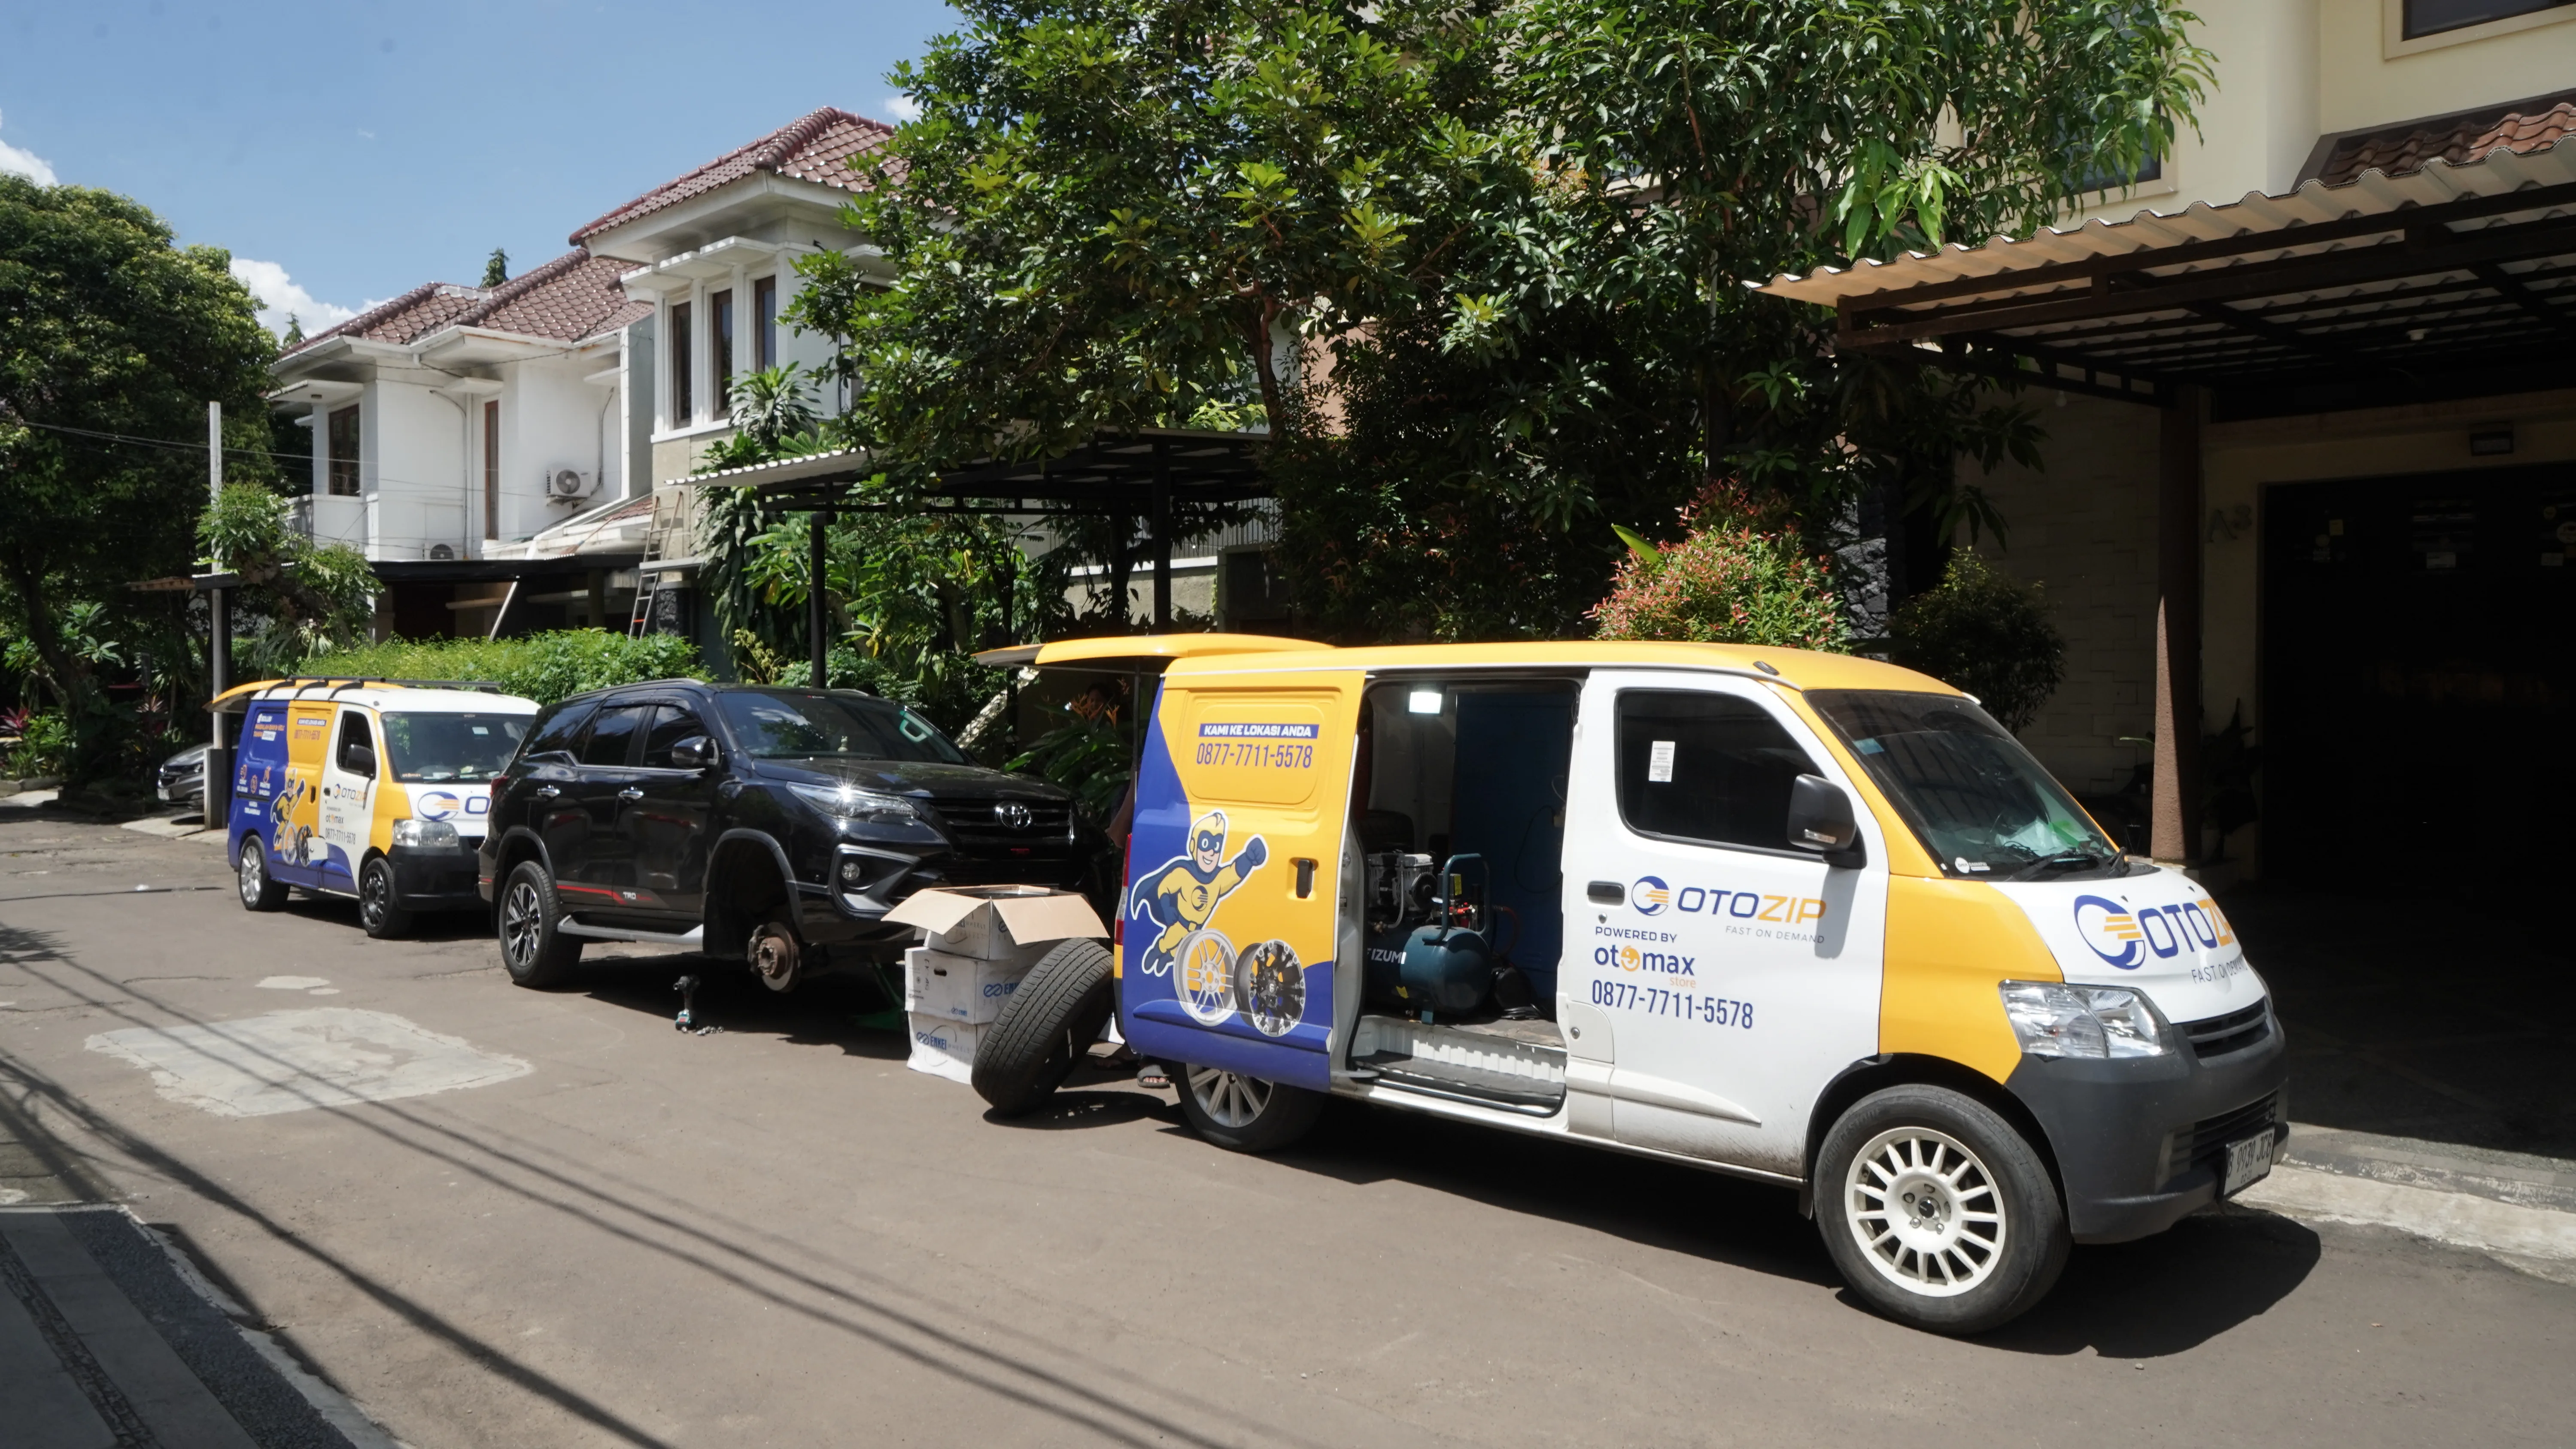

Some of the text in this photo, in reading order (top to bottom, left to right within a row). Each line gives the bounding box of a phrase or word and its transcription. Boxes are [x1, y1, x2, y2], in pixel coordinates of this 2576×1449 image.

[1204, 725, 1312, 737] KAMI KE LOKASI ANDA
[1197, 743, 1312, 768] 0877-7711-5578
[341, 788, 368, 801] OTOZIP
[325, 828, 356, 845] 0877-7711-5578
[1678, 887, 1826, 924] OTOZIP
[1596, 927, 1677, 943] POWERED BY
[1725, 925, 1824, 943] FAST ON DEMAND
[1595, 945, 1695, 976] otomax
[1670, 976, 1696, 988] store
[2191, 966, 2216, 984] FAST
[1592, 980, 1753, 1029] 0877-7711-5578
[930, 1036, 947, 1050] ENKEI
